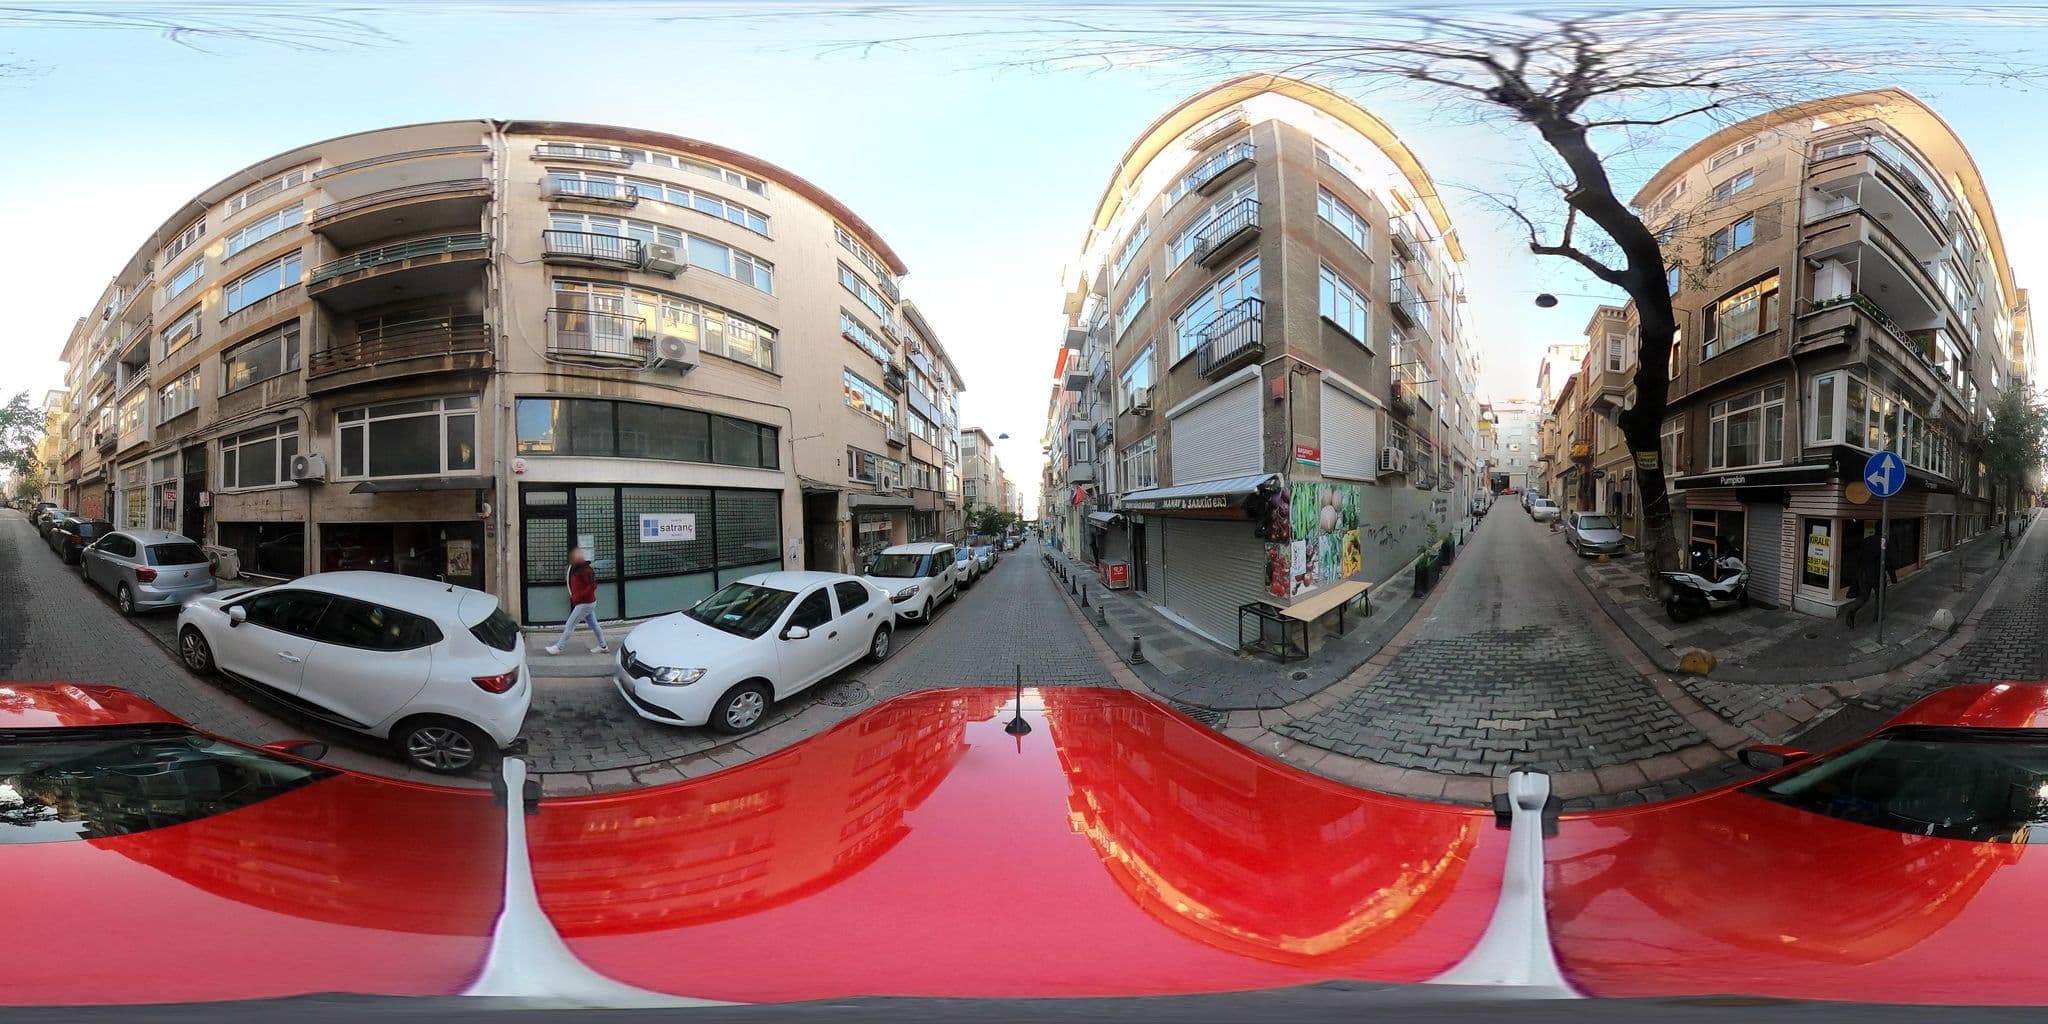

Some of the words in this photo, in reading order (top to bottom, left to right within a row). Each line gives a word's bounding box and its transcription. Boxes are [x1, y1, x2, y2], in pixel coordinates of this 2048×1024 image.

[1720, 474, 1746, 487] Pumpkin
[1162, 499, 1181, 508] MANAV
[660, 524, 693, 533] satranç
